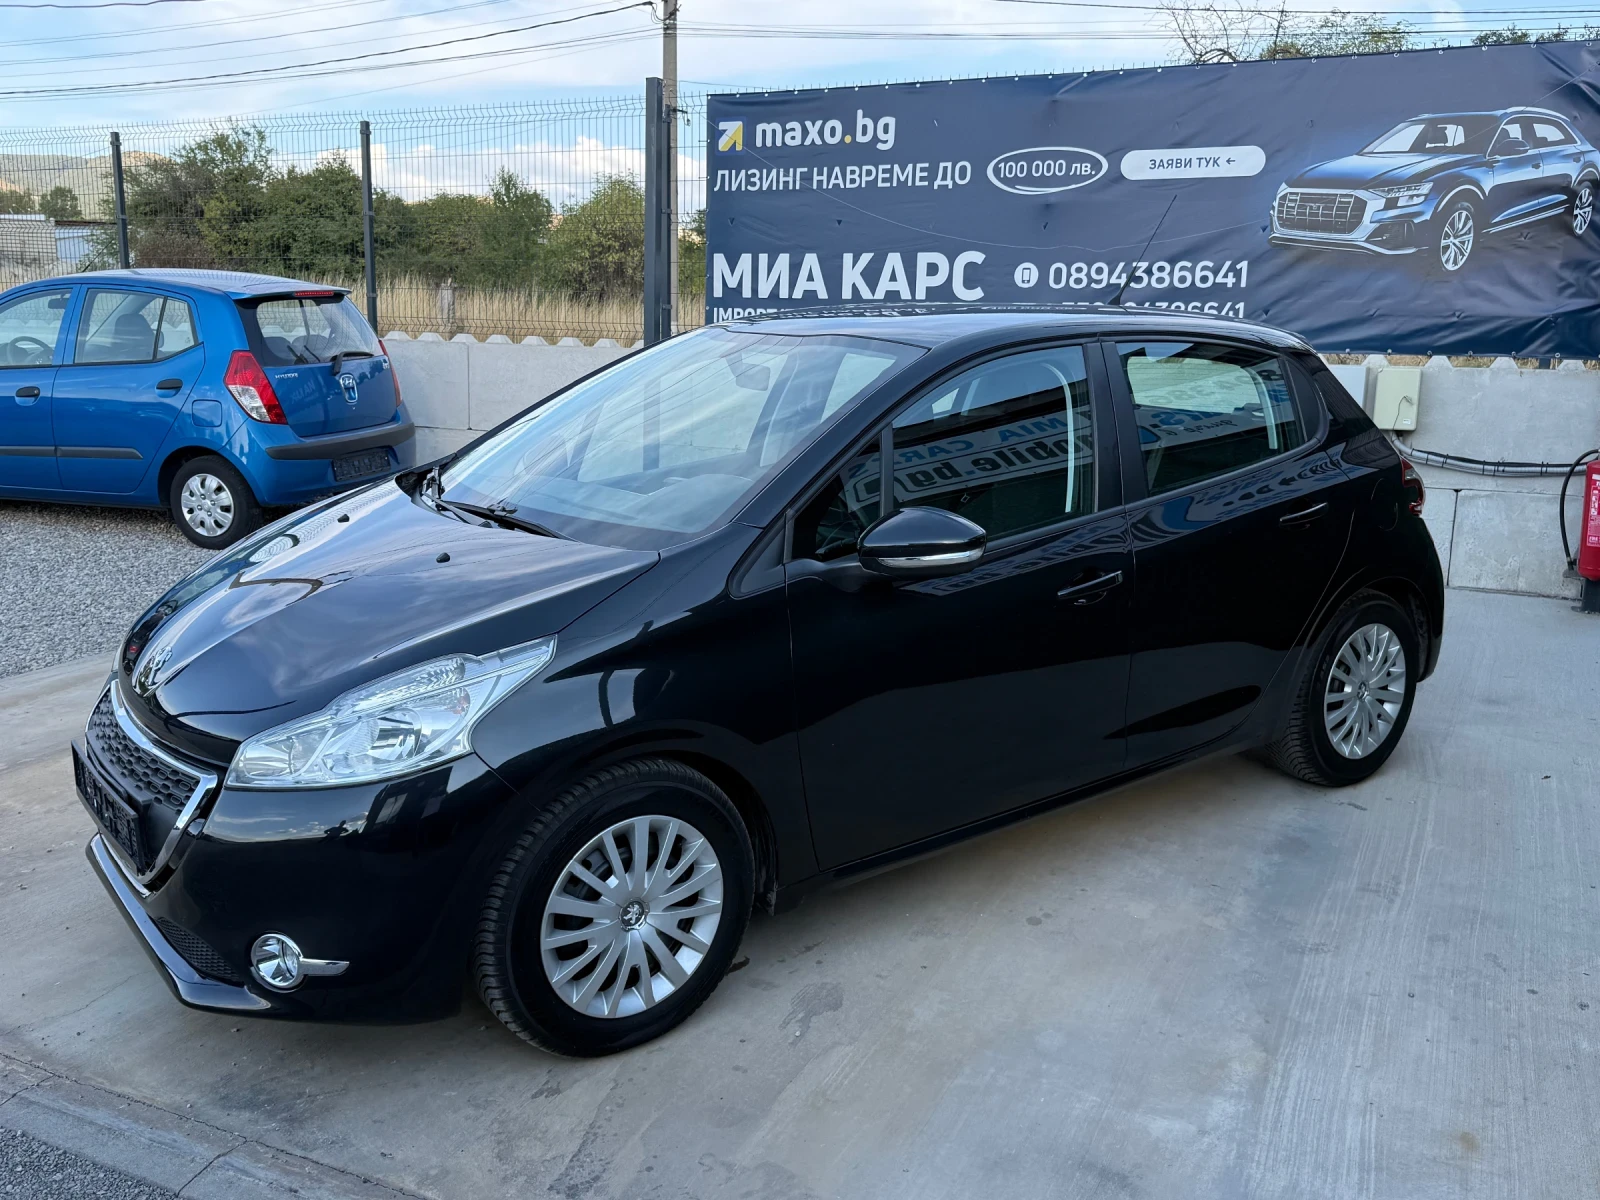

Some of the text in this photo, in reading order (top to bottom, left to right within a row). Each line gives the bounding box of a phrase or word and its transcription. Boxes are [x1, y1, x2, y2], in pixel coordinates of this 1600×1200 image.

[755, 109, 896, 151] maxo.bg
[714, 159, 1097, 192] ЛИЗИНГ НАВРЕМЕ ДО 100 000 лв.
[1148, 156, 1221, 170] ЗАЯВИ ТУК
[713, 250, 986, 301] МИА КАРС
[1048, 260, 1249, 289] 0894386641
